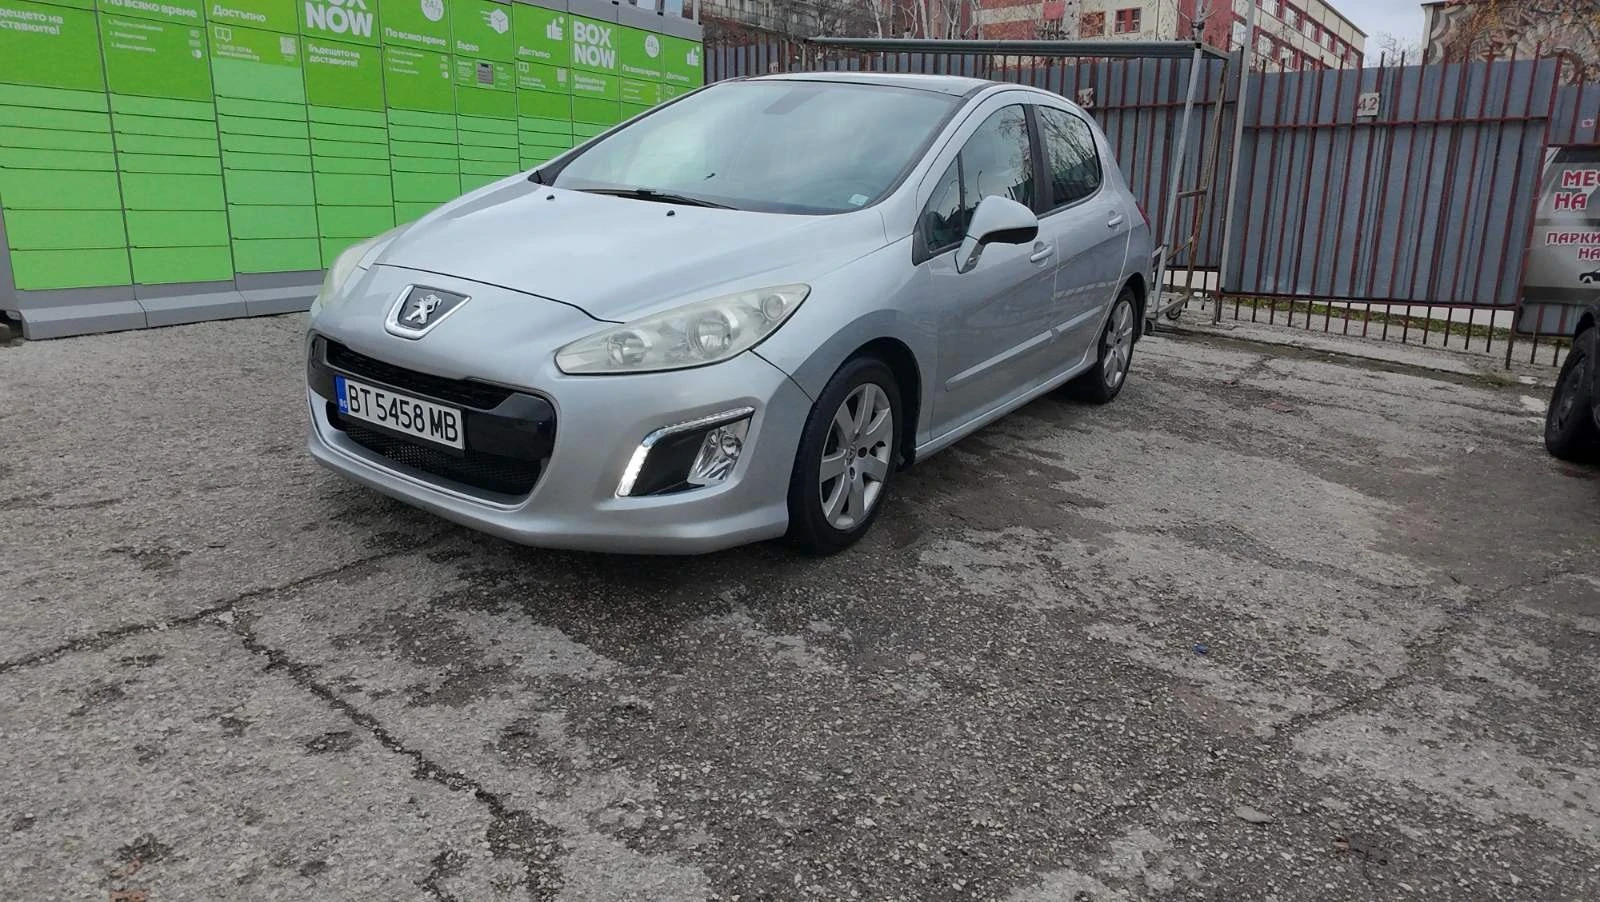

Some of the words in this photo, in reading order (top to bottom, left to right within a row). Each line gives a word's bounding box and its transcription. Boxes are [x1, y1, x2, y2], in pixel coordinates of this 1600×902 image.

[213, 5, 266, 22] Достъпно
[305, 1, 374, 38] NOW
[573, 20, 612, 49] BOX
[574, 42, 616, 70] NOW
[1358, 97, 1378, 112] 42
[1562, 170, 1600, 188] МЕ
[1554, 192, 1588, 211] НА
[348, 384, 371, 417] BT
[375, 391, 426, 433] 5458
[429, 406, 458, 442] MB
